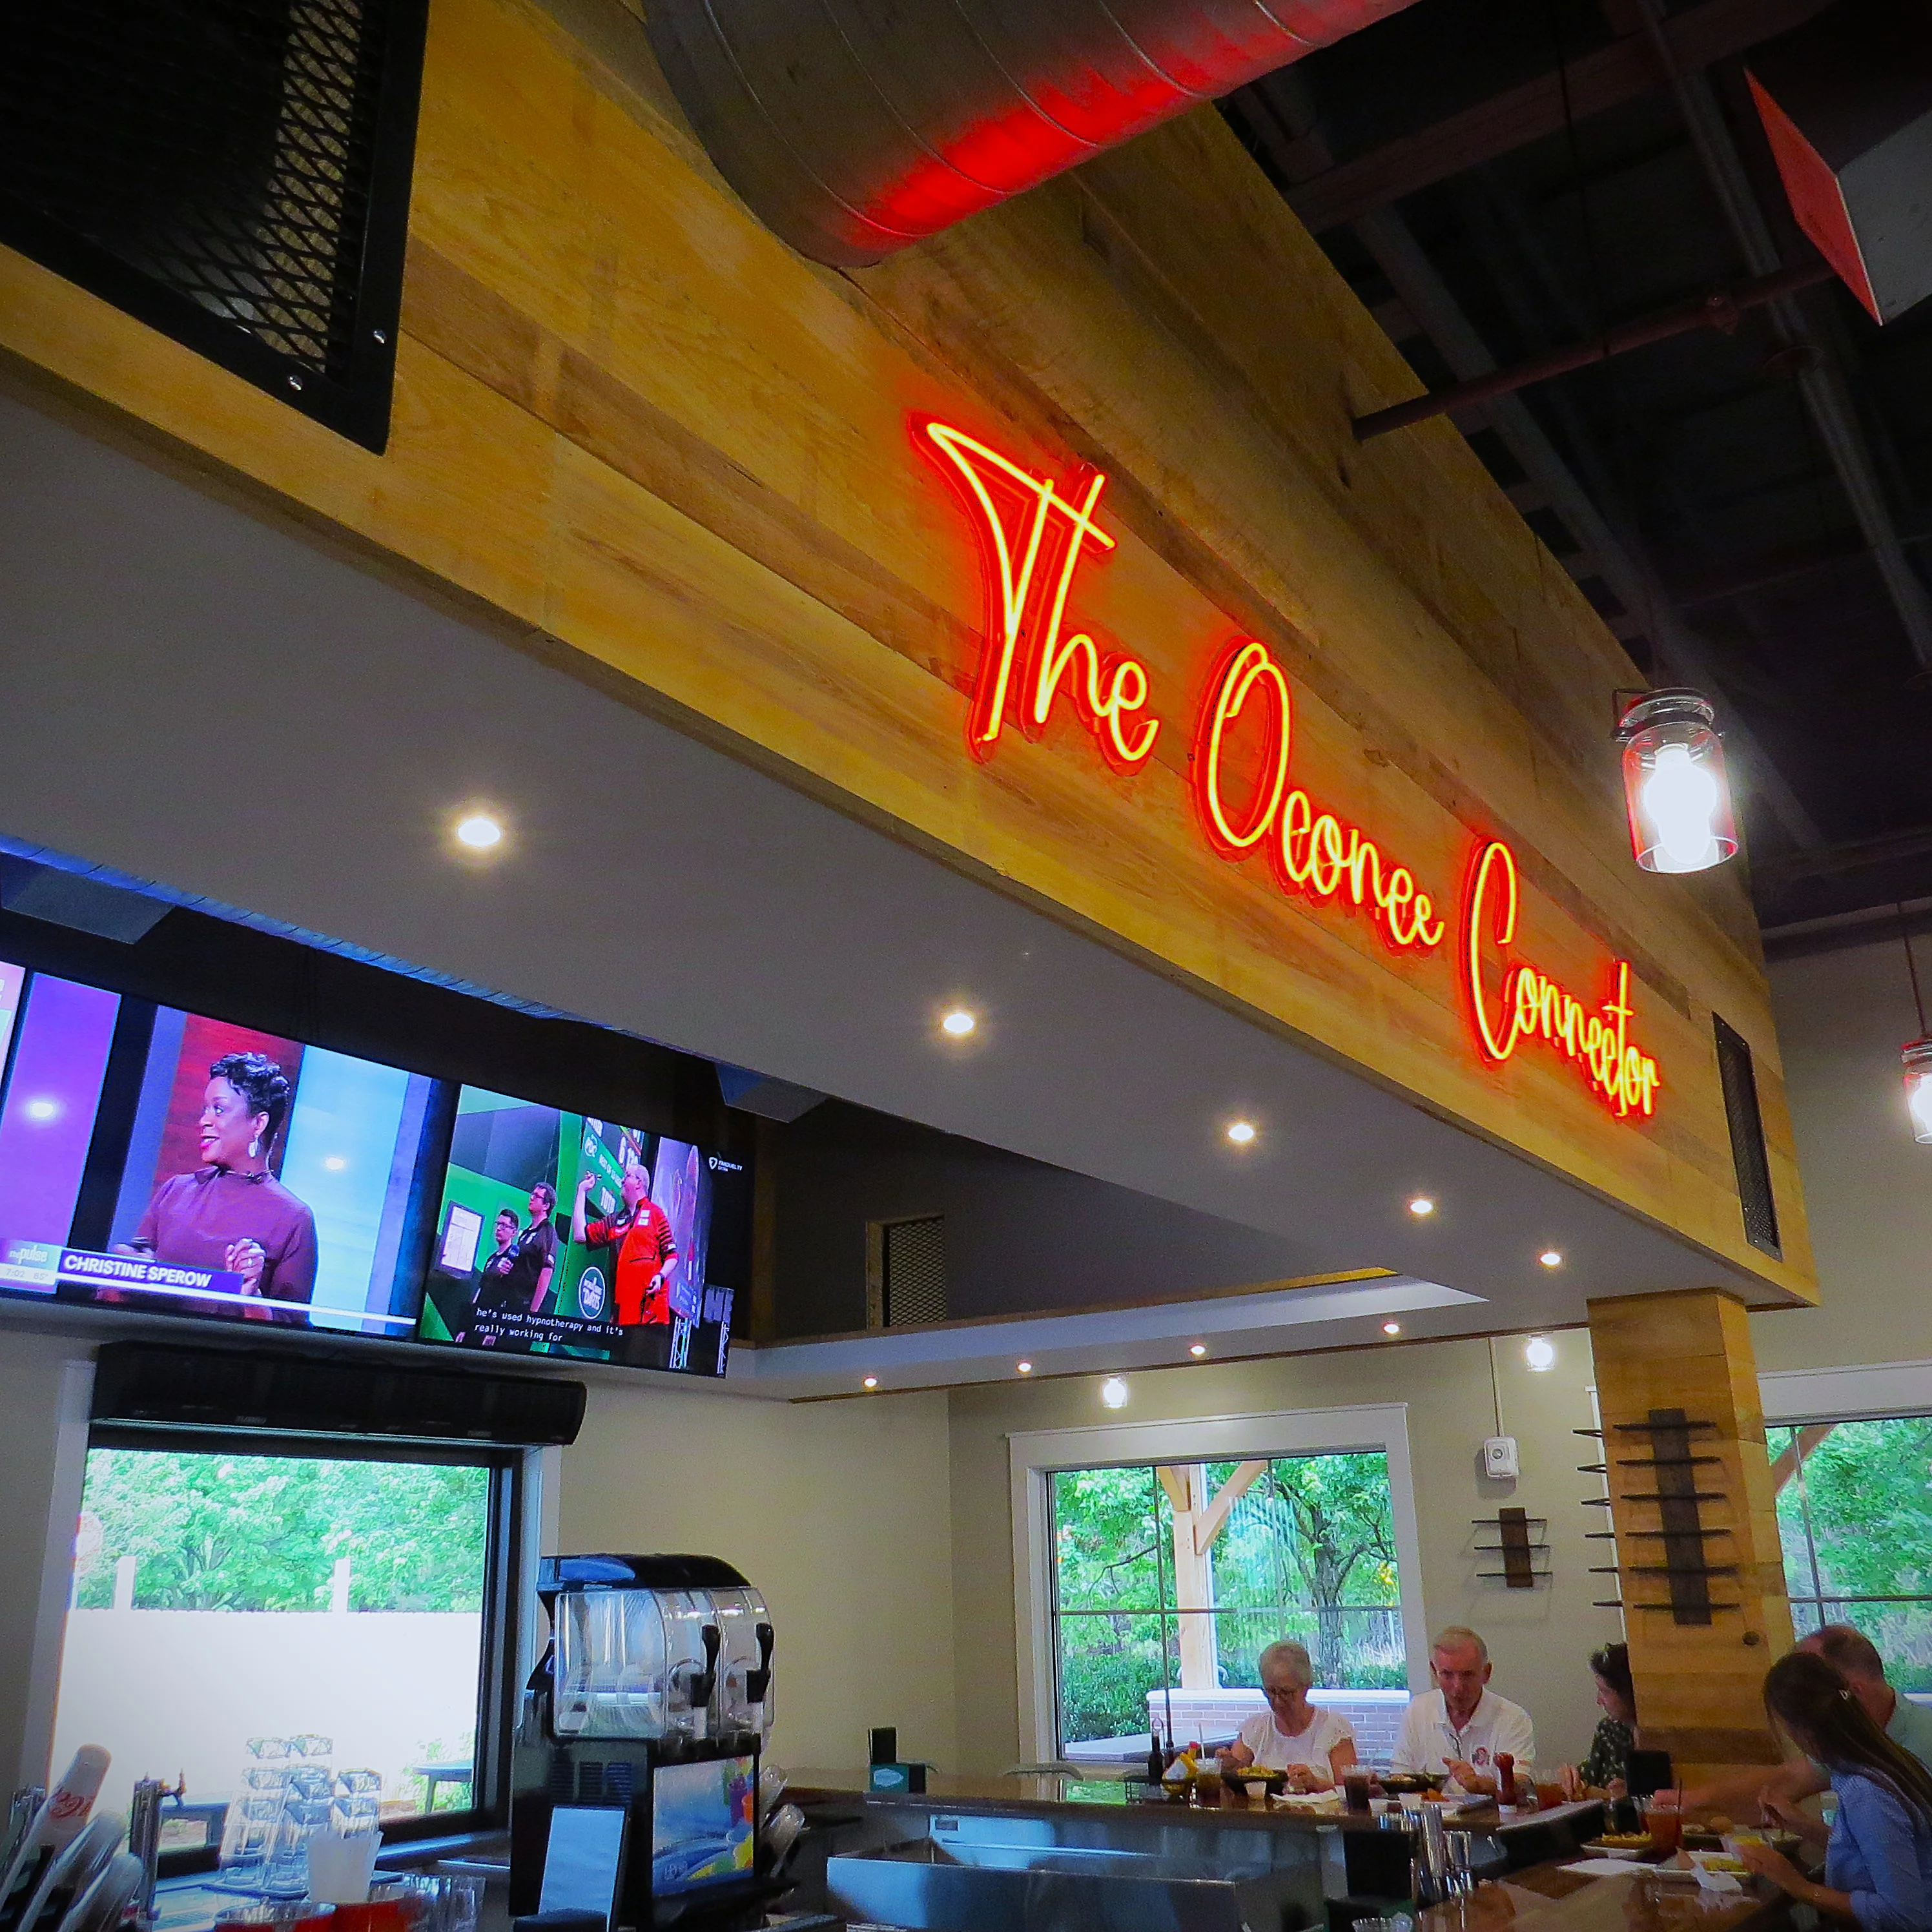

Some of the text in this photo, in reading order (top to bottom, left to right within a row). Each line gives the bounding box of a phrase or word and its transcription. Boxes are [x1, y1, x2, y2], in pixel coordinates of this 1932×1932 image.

[922, 420, 1160, 763] The
[1467, 840, 1661, 1117] Connector
[18, 1244, 48, 1266] pulse
[65, 1254, 212, 1288] CHRISTINE SPEROW
[474, 1324, 564, 1341] really working for
[476, 1307, 497, 1318] he's
[501, 1313, 522, 1322] used
[526, 1315, 584, 1331] hypnotherapy
[606, 1325, 624, 1335] it's
